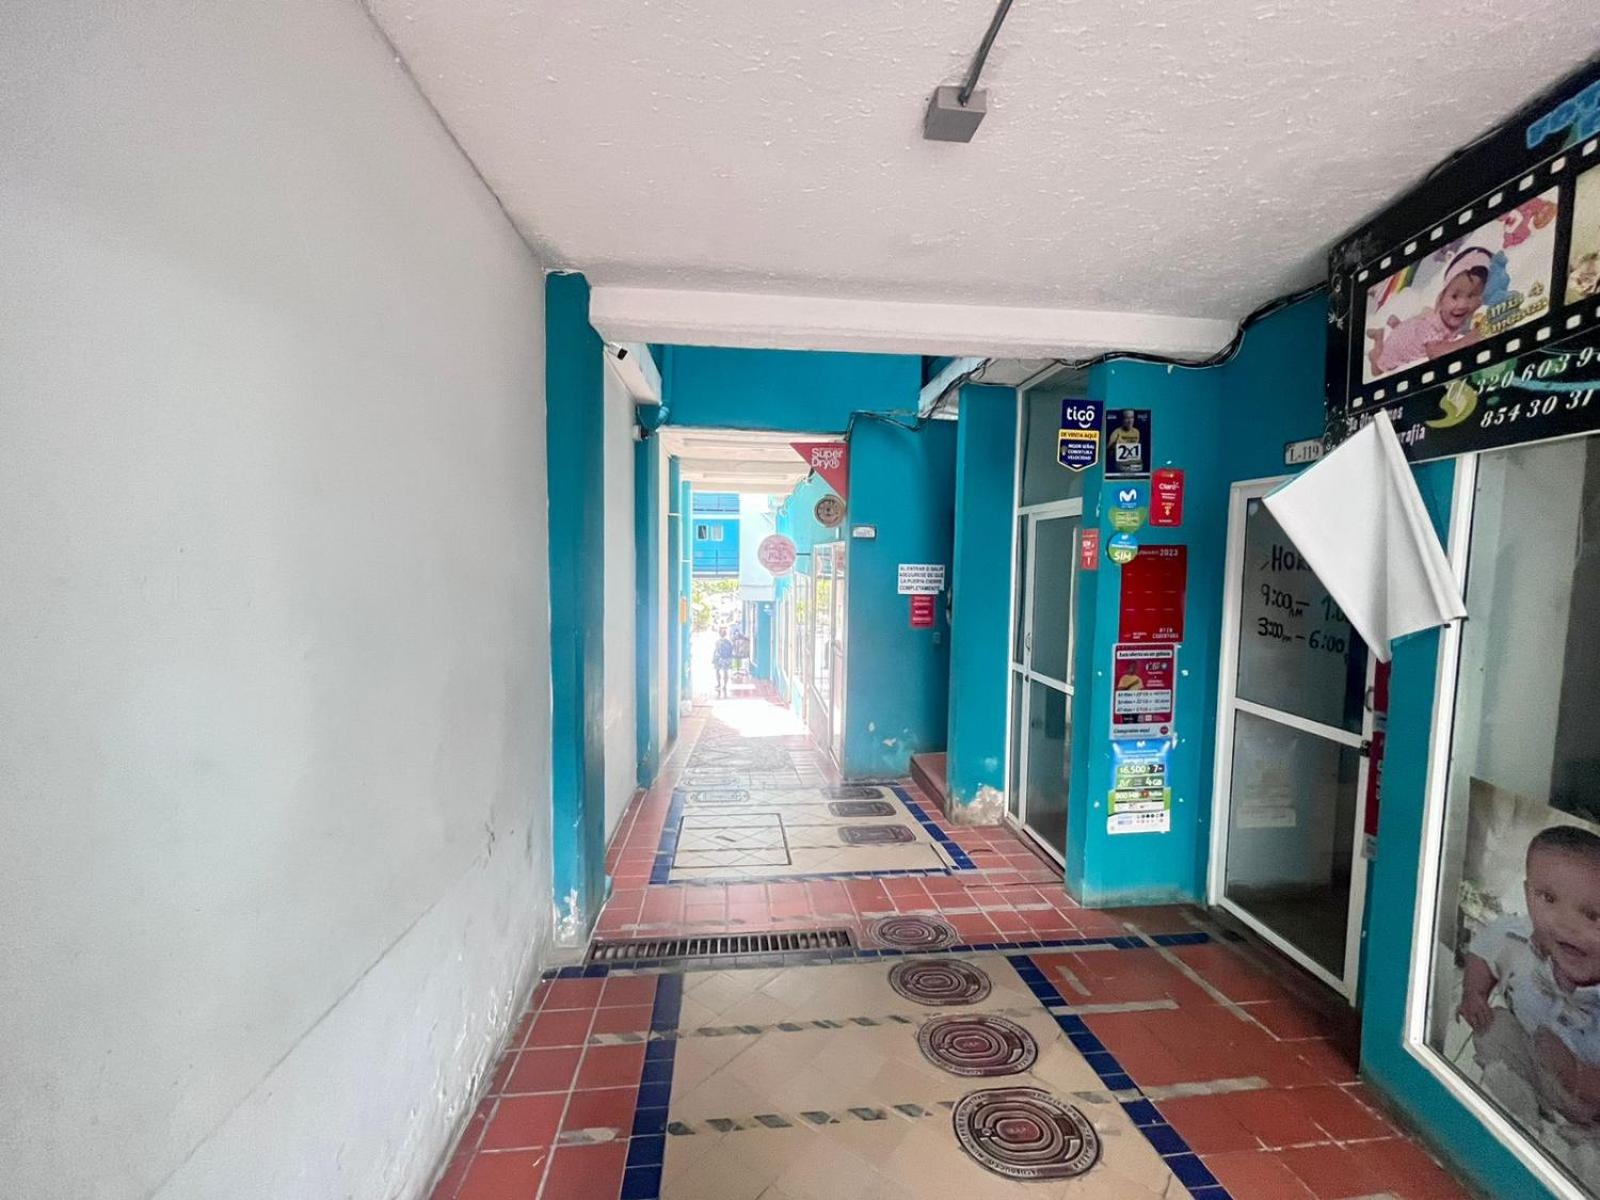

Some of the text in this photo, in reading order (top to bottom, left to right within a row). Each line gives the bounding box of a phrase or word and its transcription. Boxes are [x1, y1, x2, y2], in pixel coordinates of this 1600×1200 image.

[1477, 370, 1515, 395] 320
[1521, 353, 1571, 382] 603
[1480, 388, 1595, 428] 854 30 31
[811, 448, 843, 461] Super
[1114, 551, 1132, 561] SIM
[1261, 583, 1293, 609] 9:00
[1257, 617, 1284, 639] 3:00
[1309, 630, 1346, 653] 6:00
